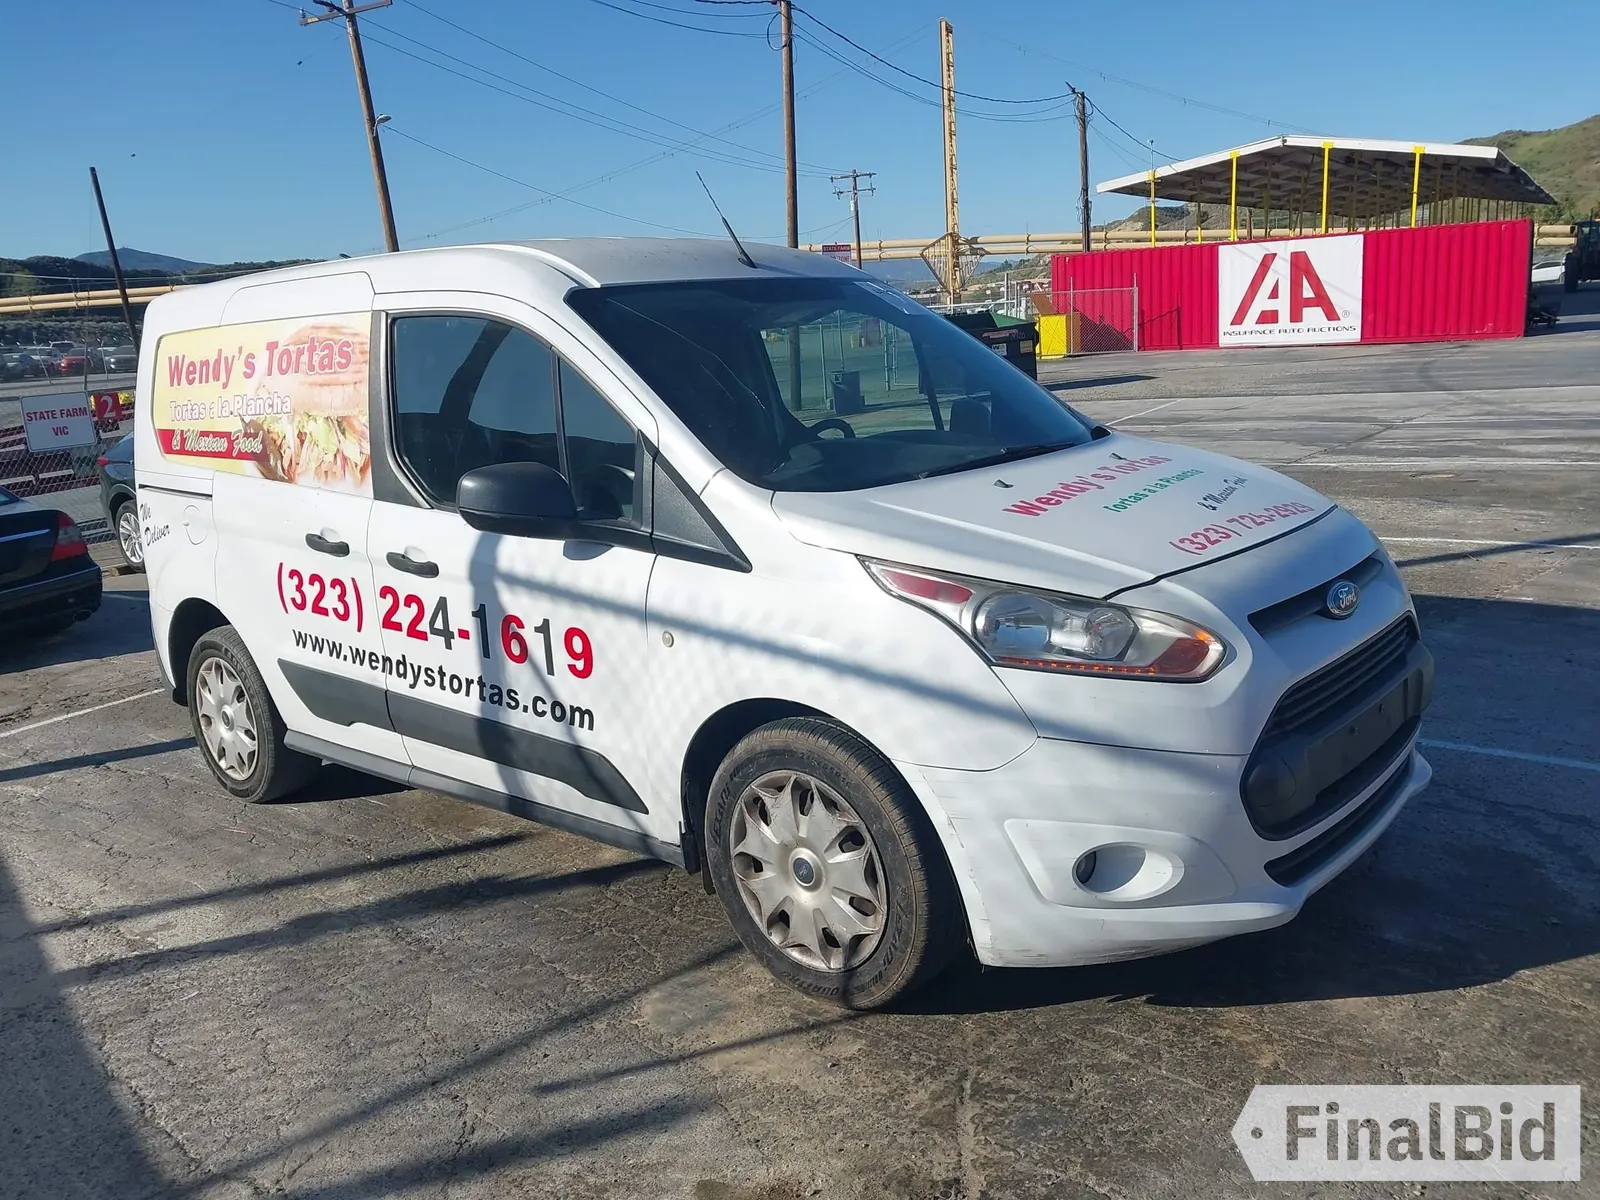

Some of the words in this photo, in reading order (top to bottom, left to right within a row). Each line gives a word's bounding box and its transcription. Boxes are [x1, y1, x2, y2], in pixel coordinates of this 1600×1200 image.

[1279, 327, 1304, 335] AUTO
[1307, 325, 1357, 333] AUCTIONS
[168, 346, 256, 389] Wendy's
[265, 336, 353, 377] Tortas
[26, 409, 58, 422] STATE
[60, 406, 88, 418] FARM
[100, 395, 116, 418] 2
[170, 400, 207, 421] Tortas
[217, 396, 231, 418] la
[233, 391, 292, 416] Plancha
[52, 425, 70, 437] VIC
[183, 428, 228, 452] Mexican
[231, 428, 263, 457] Food
[1002, 464, 1117, 517] Wendy's
[1097, 455, 1173, 475] Tortas
[1102, 489, 1149, 513] Tortas
[1168, 523, 1243, 556] (323)
[1226, 501, 1315, 530] 725-2929
[1338, 586, 1357, 609] Ford
[277, 562, 364, 633] (323)
[378, 585, 594, 679] 224-1619
[292, 628, 595, 731] www.wendystortas.com
